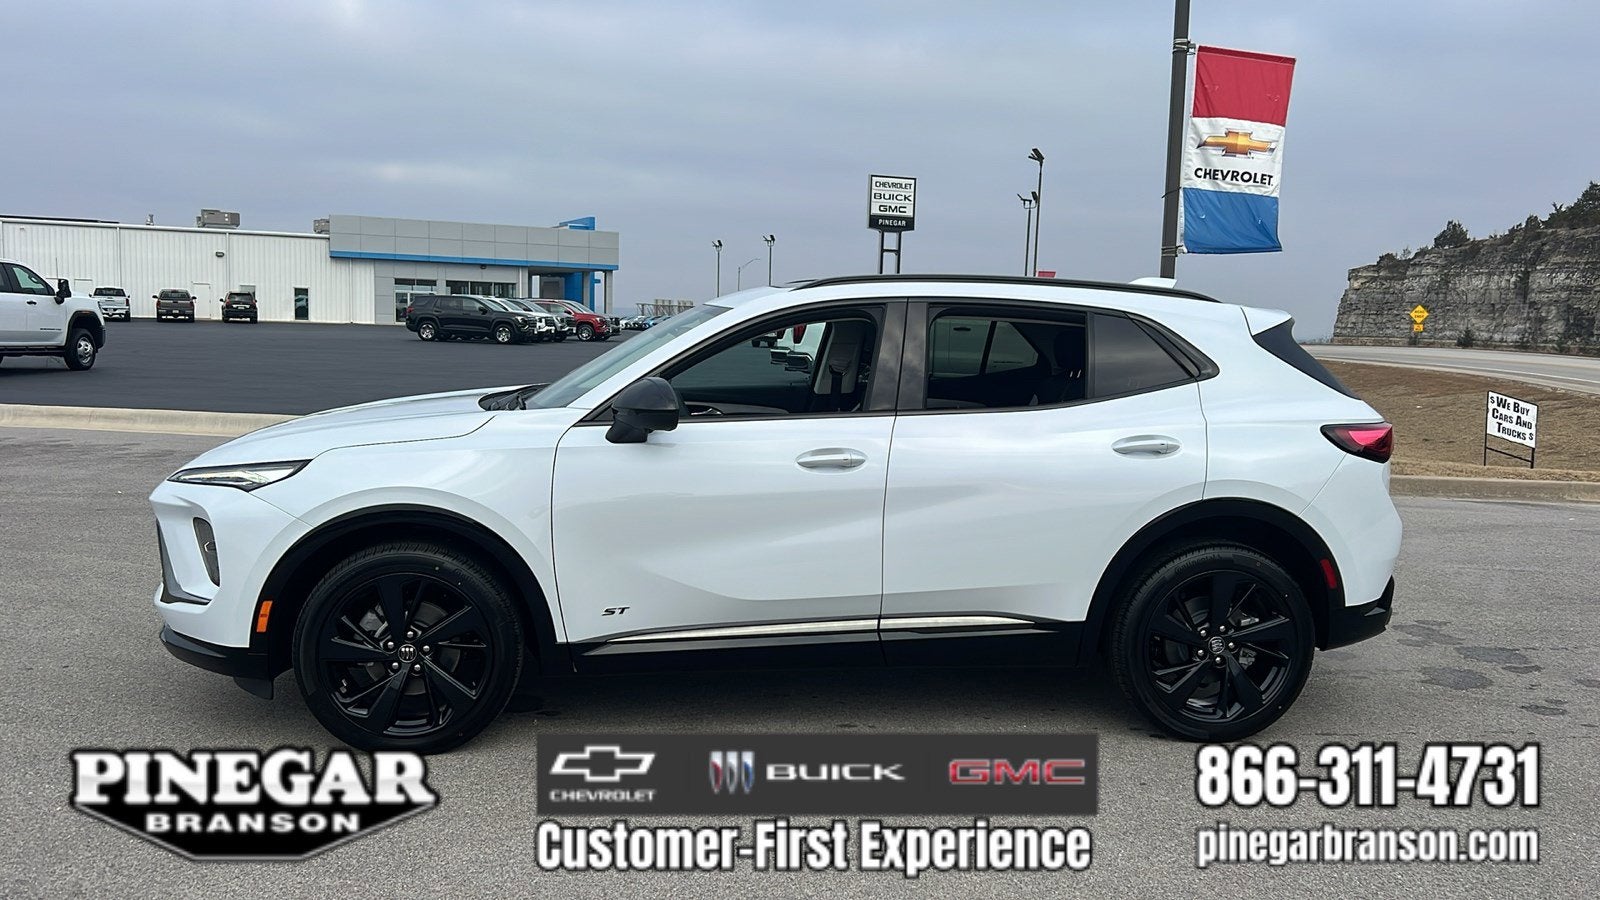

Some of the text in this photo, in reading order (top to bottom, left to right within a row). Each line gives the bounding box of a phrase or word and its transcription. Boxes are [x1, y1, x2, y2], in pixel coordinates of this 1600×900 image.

[1194, 167, 1274, 186] CHEVROLET
[875, 181, 912, 190] CHEVROLET
[873, 192, 912, 202] BUICK
[878, 204, 907, 214] GMC
[878, 219, 906, 227] PINEGAR
[601, 606, 630, 616] ST
